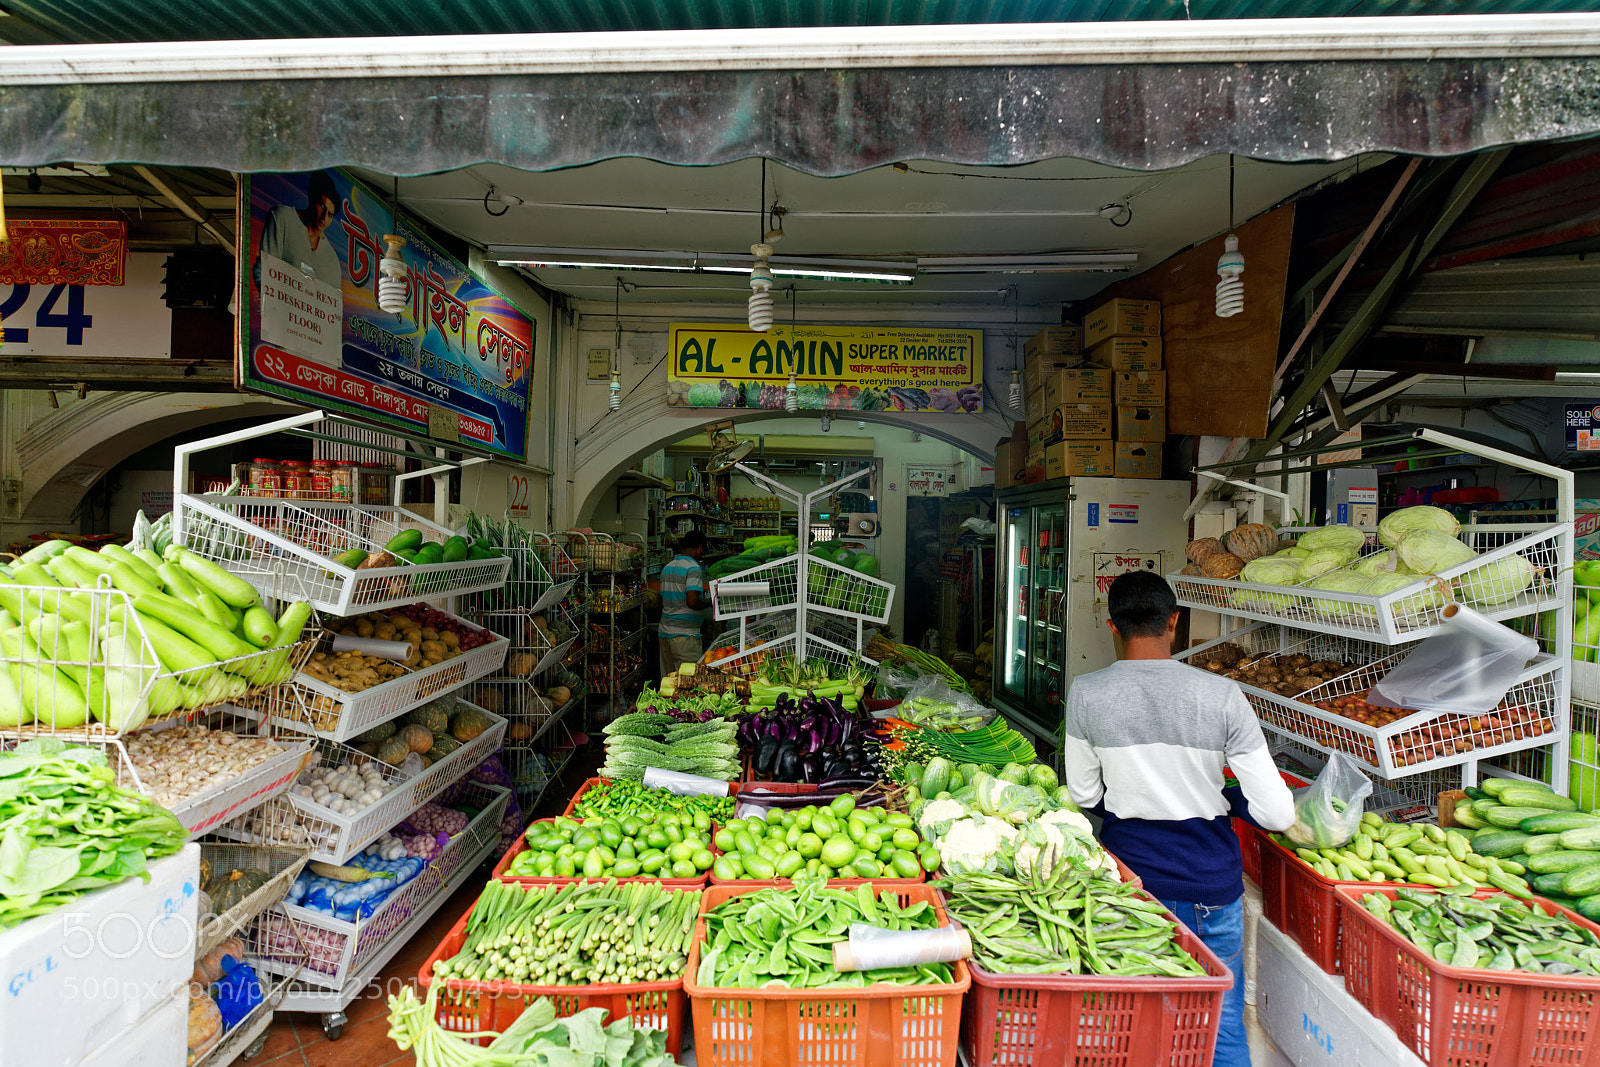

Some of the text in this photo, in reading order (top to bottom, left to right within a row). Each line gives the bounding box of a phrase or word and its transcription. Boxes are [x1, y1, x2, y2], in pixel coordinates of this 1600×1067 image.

[269, 268, 304, 292] OFFICE
[316, 291, 338, 308] RENT
[264, 285, 275, 298] 22
[277, 290, 313, 314] DESKER
[314, 307, 326, 320] RD
[288, 312, 322, 335] FLOOR)
[679, 337, 725, 373] AL
[749, 338, 844, 376] AMIN
[848, 343, 968, 362] SUPER MARKET
[378, 360, 450, 400] ২য় তলায় সেলুন
[849, 362, 968, 378] আল-আমিন সুপার মার্কেট
[264, 353, 290, 380] ২২,
[341, 380, 368, 403] রোড,
[372, 383, 409, 415] সিঙ্গাপুর,
[859, 377, 960, 388] everything's good here
[1566, 410, 1591, 419] SOLD
[1566, 418, 1591, 427] HERE
[510, 474, 529, 510] 22
[1115, 555, 1141, 567] উপরে
